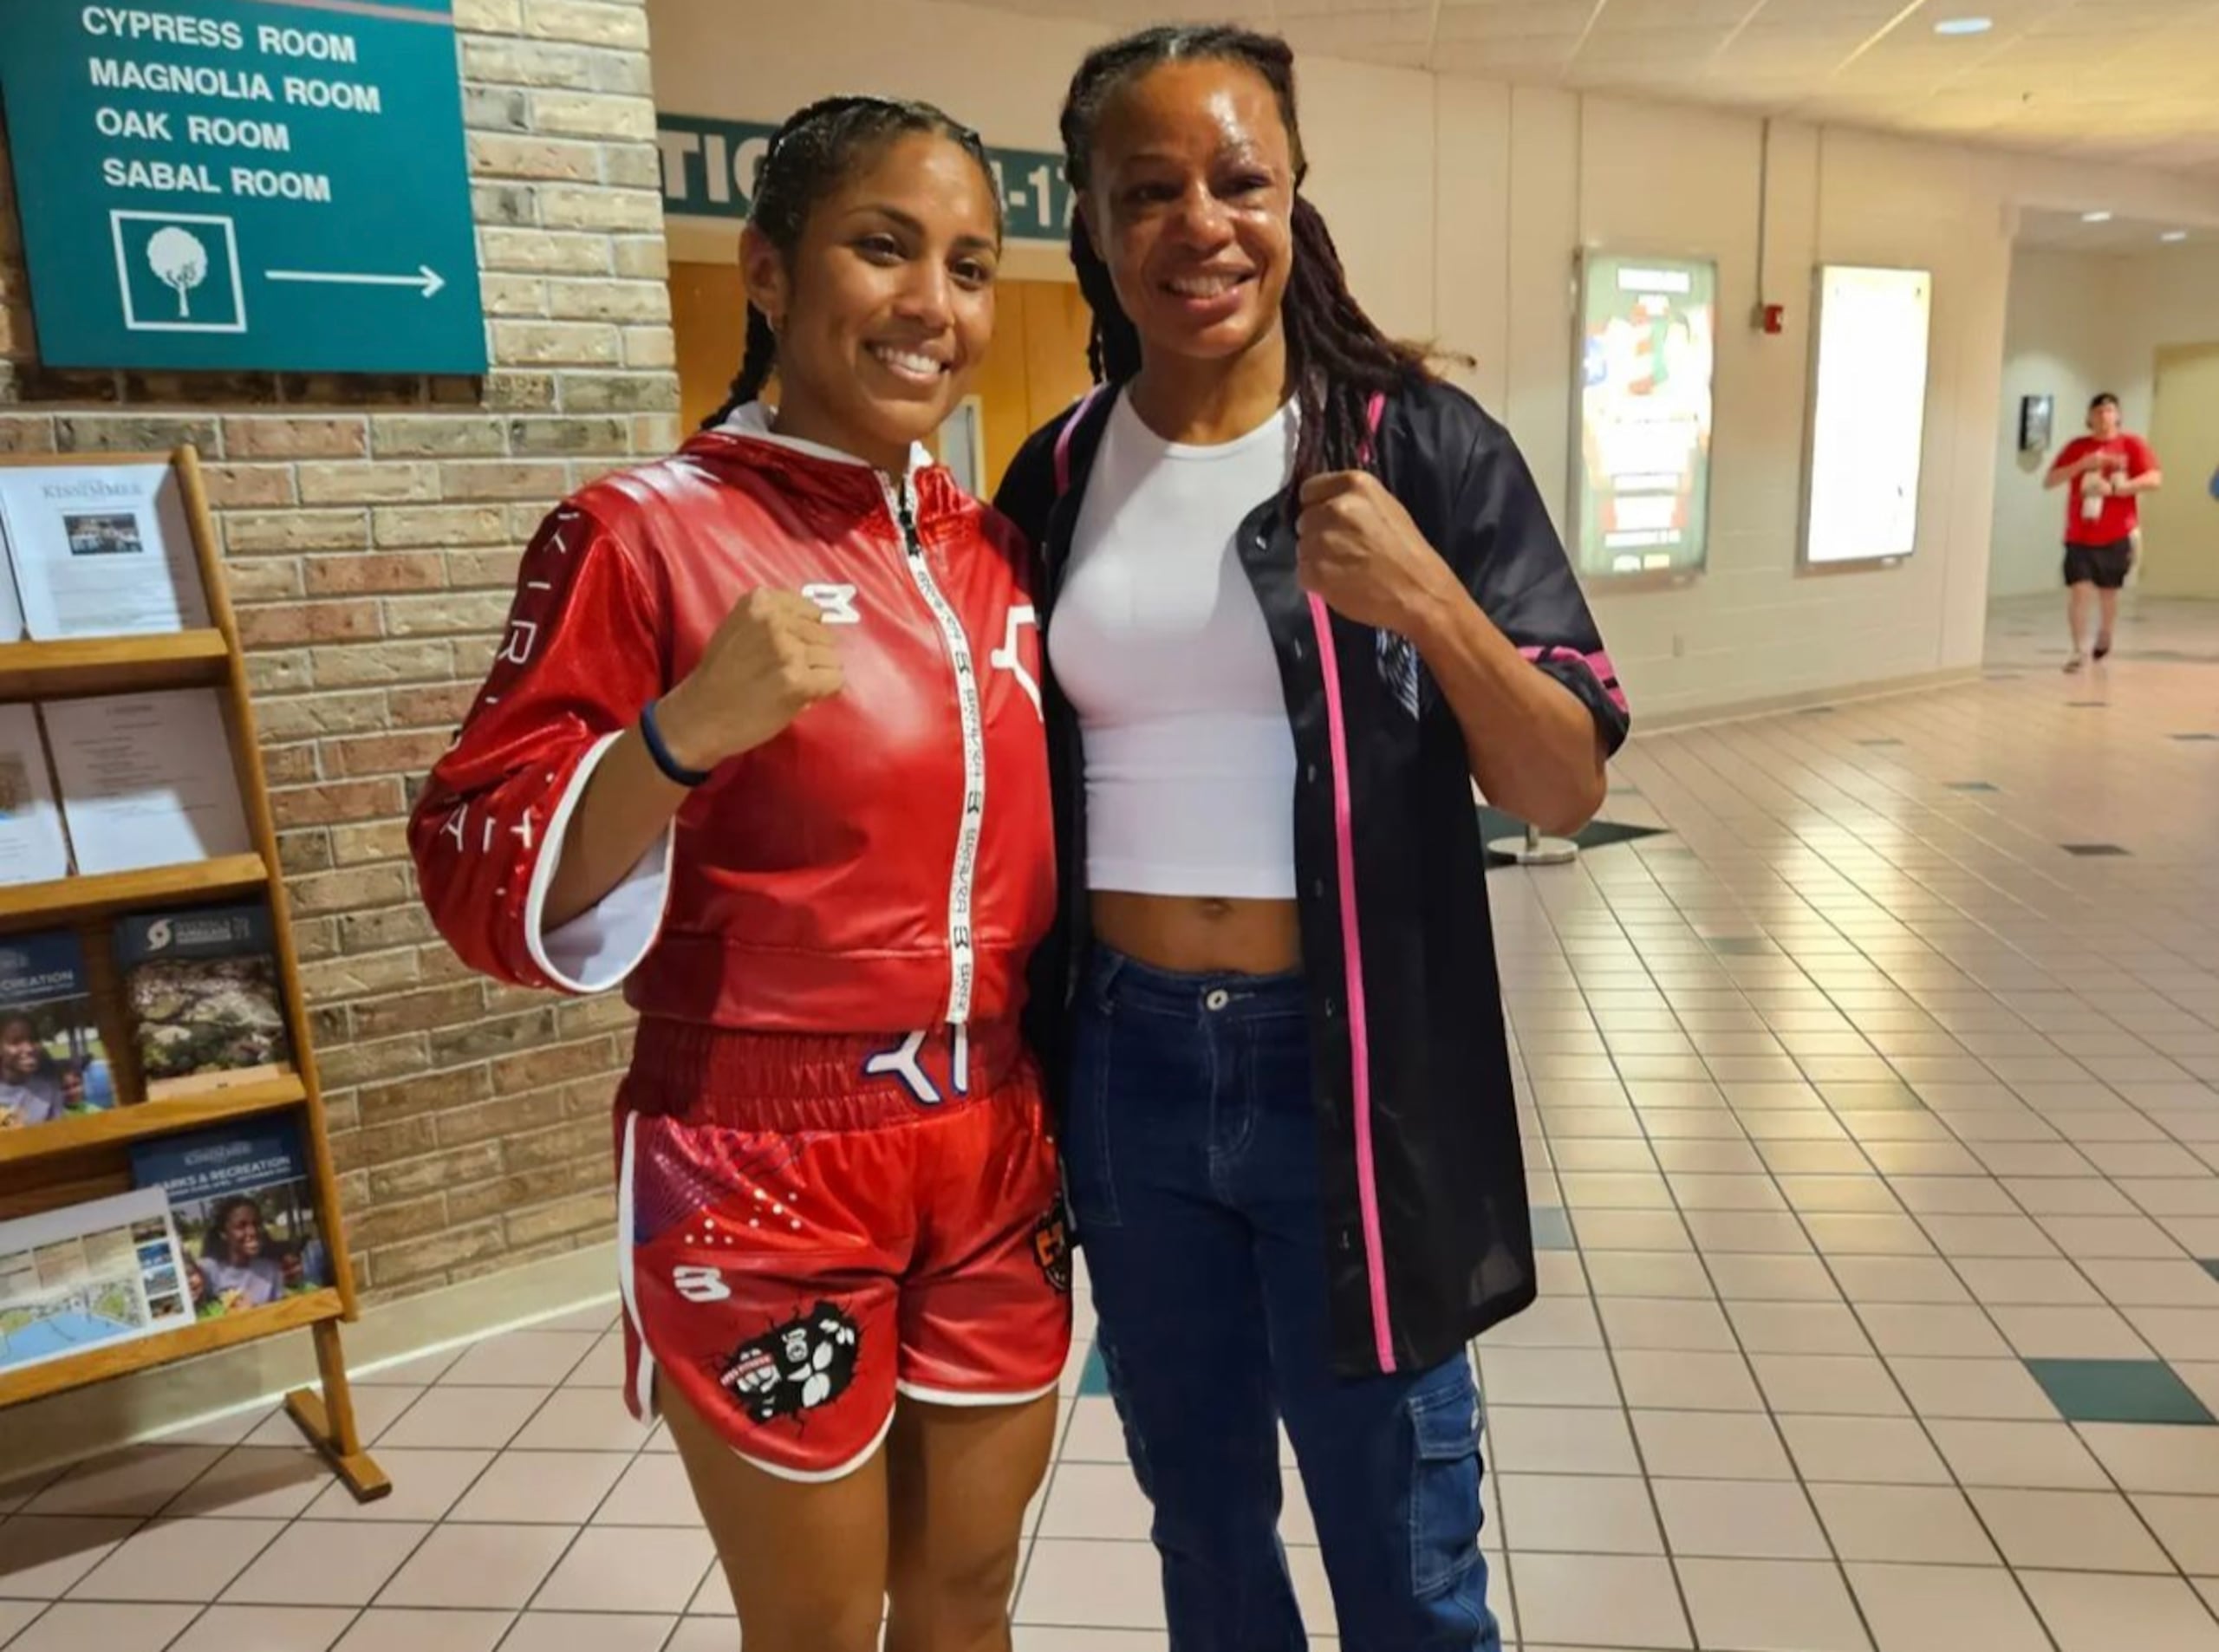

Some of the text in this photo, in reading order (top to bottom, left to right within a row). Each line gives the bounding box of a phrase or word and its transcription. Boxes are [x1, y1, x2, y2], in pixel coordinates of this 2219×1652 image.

[82, 5, 357, 63] CYPRESS ROOM
[88, 57, 381, 114] MAGNOLIA ROOM
[95, 107, 290, 152] OAK ROOM
[103, 158, 331, 202] SABAL ROOM
[210, 1156, 291, 1180] RECREATION
